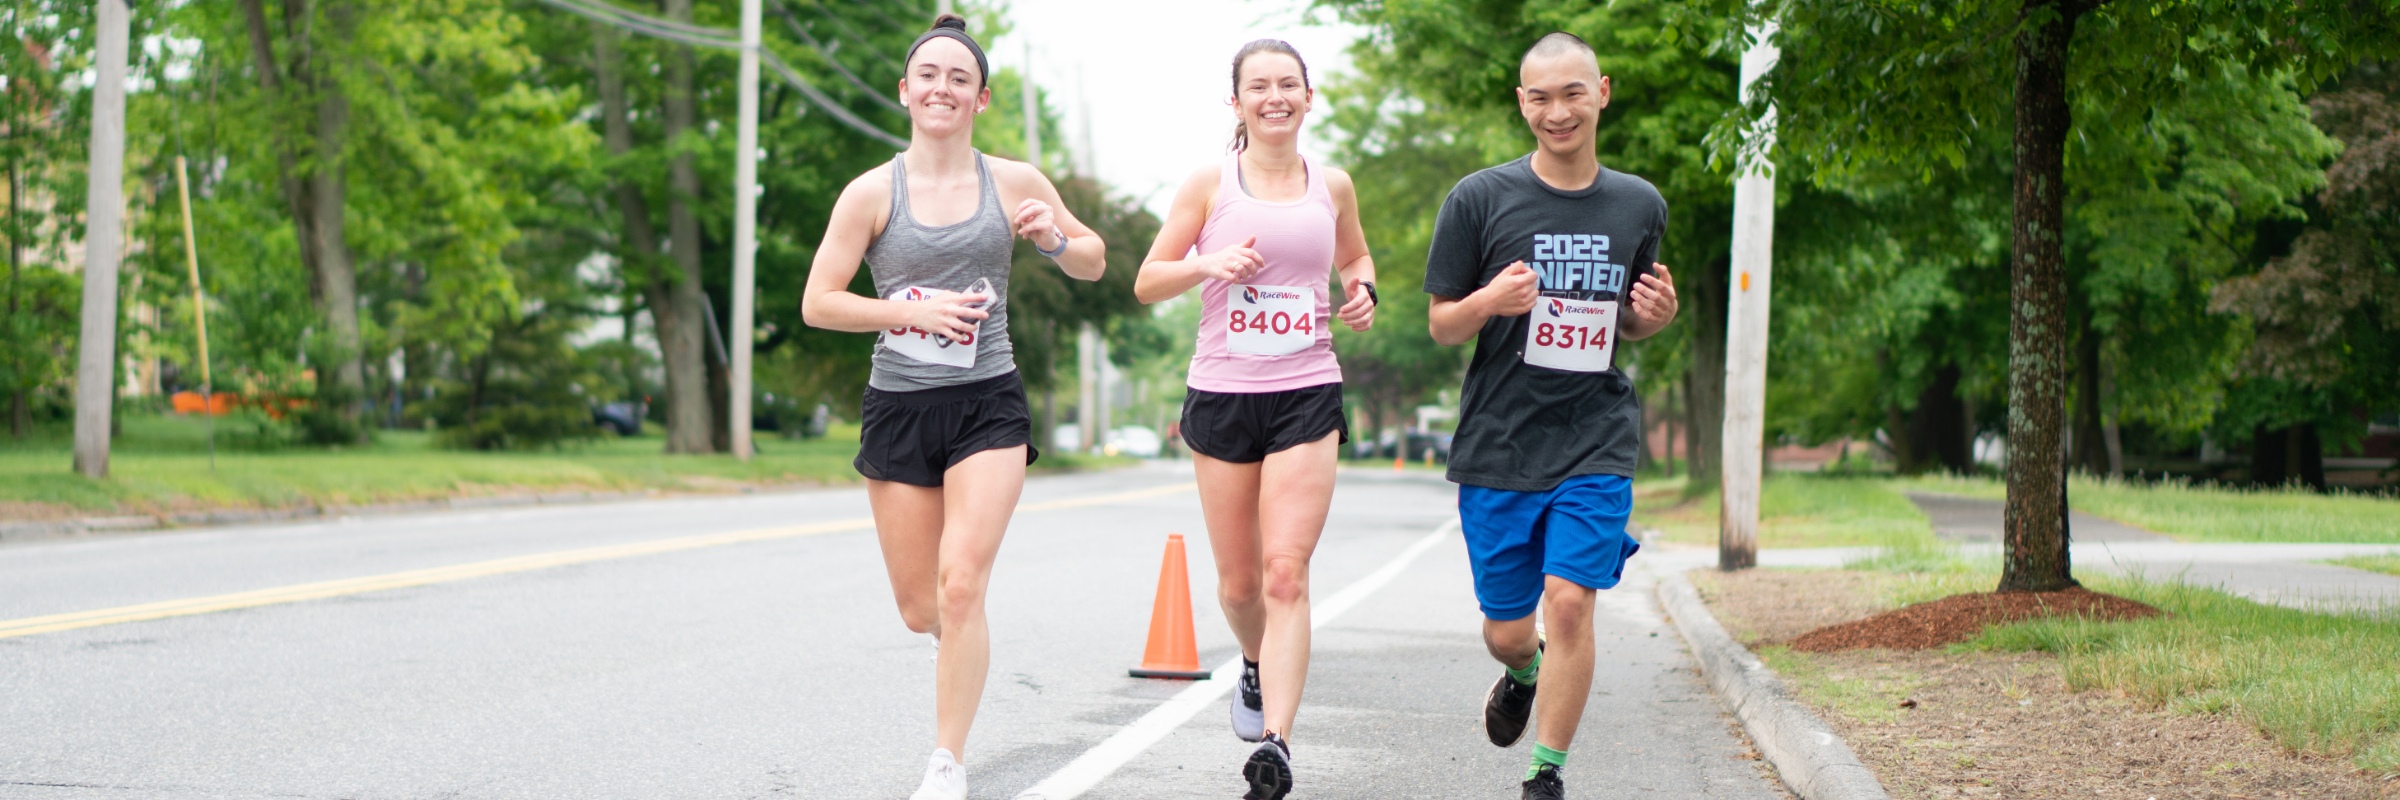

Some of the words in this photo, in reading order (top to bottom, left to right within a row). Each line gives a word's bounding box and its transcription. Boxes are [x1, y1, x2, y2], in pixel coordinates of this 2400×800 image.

[1534, 234, 1609, 261] 2022
[1511, 261, 1625, 293] NIFIED
[1260, 291, 1300, 300] RaceWire
[1229, 309, 1312, 335] 8404
[1565, 305, 1606, 315] RaceWire
[1535, 322, 1607, 351] 8314
